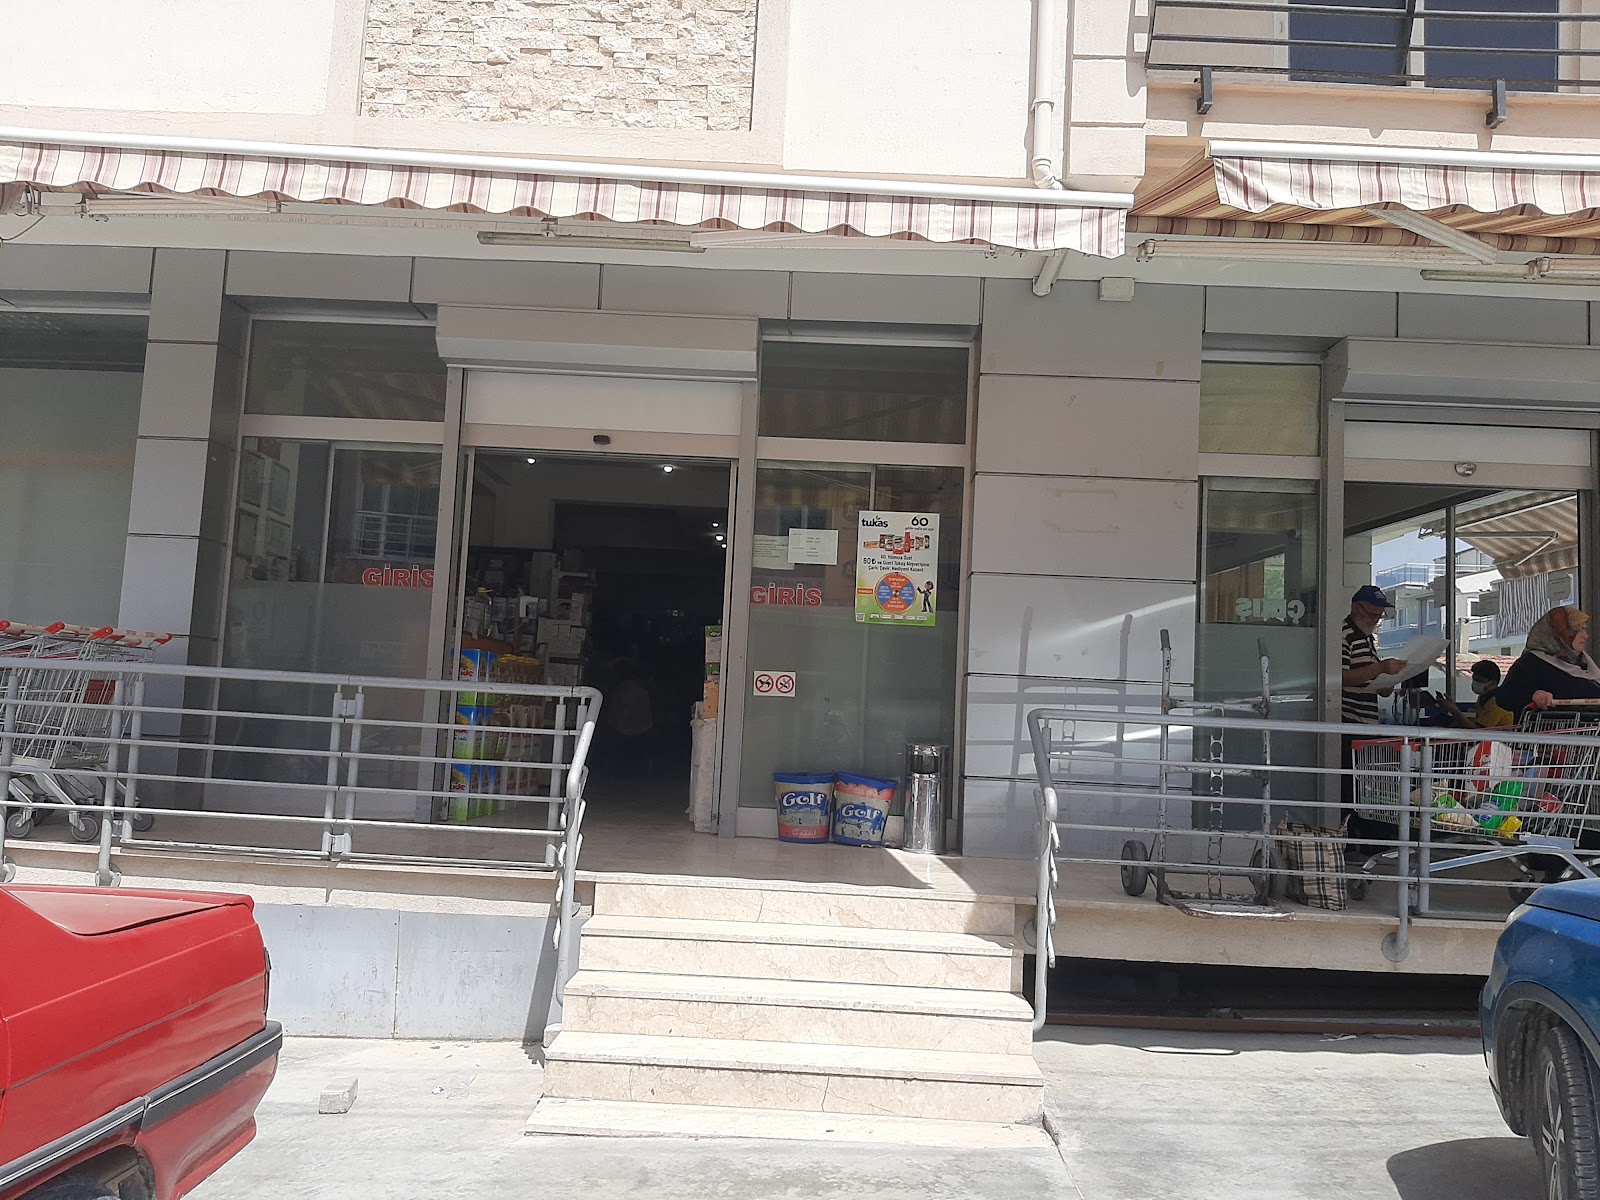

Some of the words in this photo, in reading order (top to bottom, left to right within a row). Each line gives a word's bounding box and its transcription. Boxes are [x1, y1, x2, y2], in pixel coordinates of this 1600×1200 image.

[911, 516, 929, 527] 60
[782, 792, 825, 808] Golf
[841, 804, 881, 820] Golf
